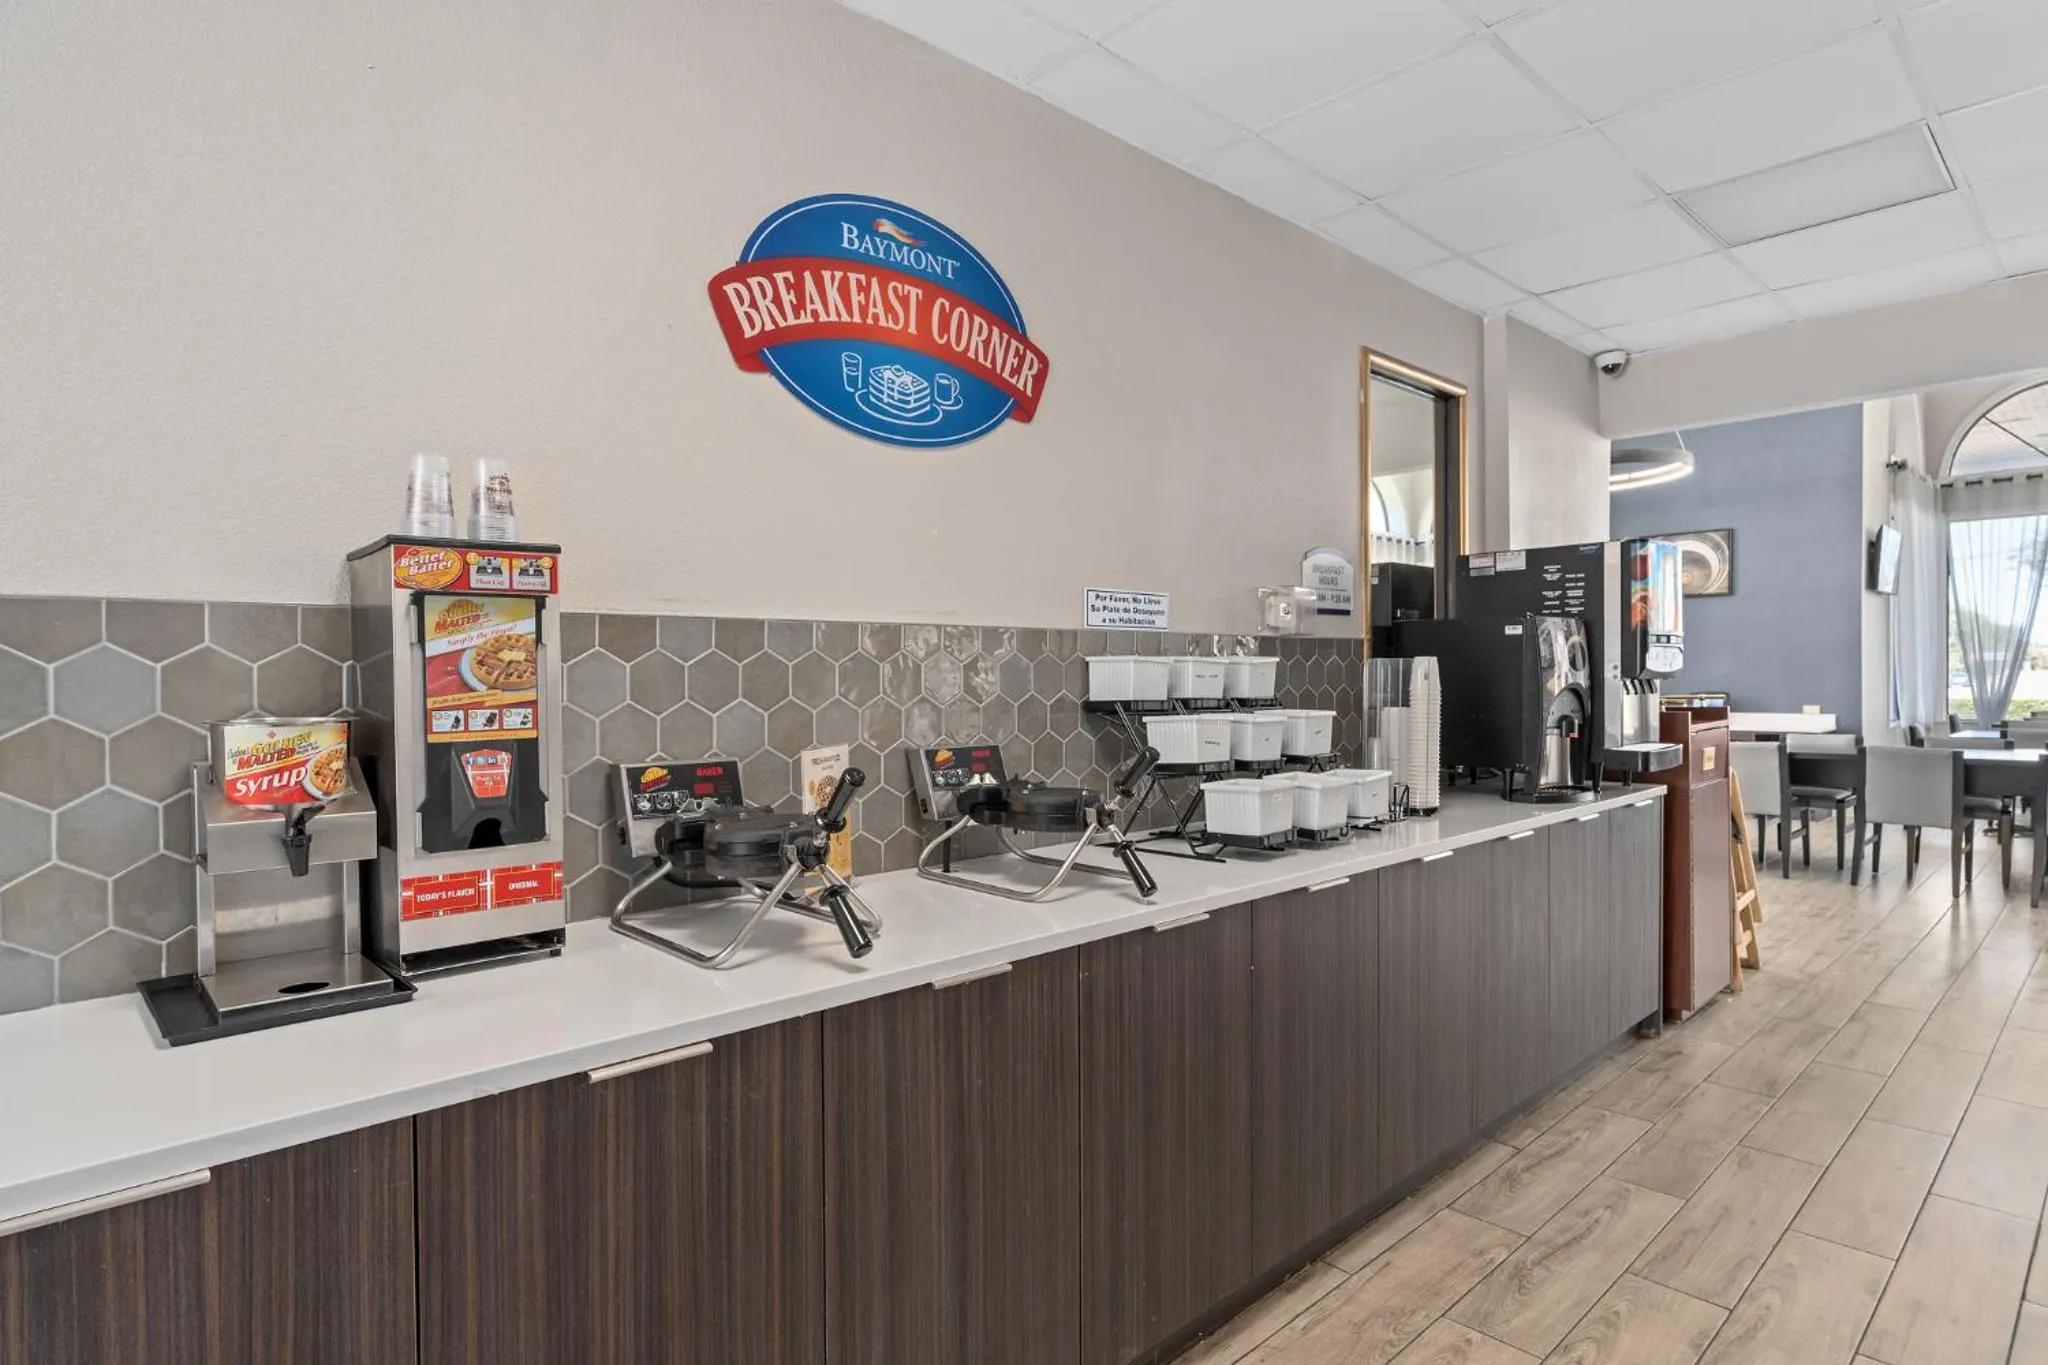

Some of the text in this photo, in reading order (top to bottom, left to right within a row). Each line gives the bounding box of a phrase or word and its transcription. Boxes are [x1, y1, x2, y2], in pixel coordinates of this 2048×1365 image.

[840, 221, 959, 280] BAYMONT
[723, 269, 1040, 399] BREAKFAST CORNER
[400, 551, 446, 567] Better
[409, 559, 454, 576] Batter
[236, 747, 297, 770] MALTED
[232, 766, 308, 797] Syrup
[416, 887, 475, 903] TODAY'S FLAVOR
